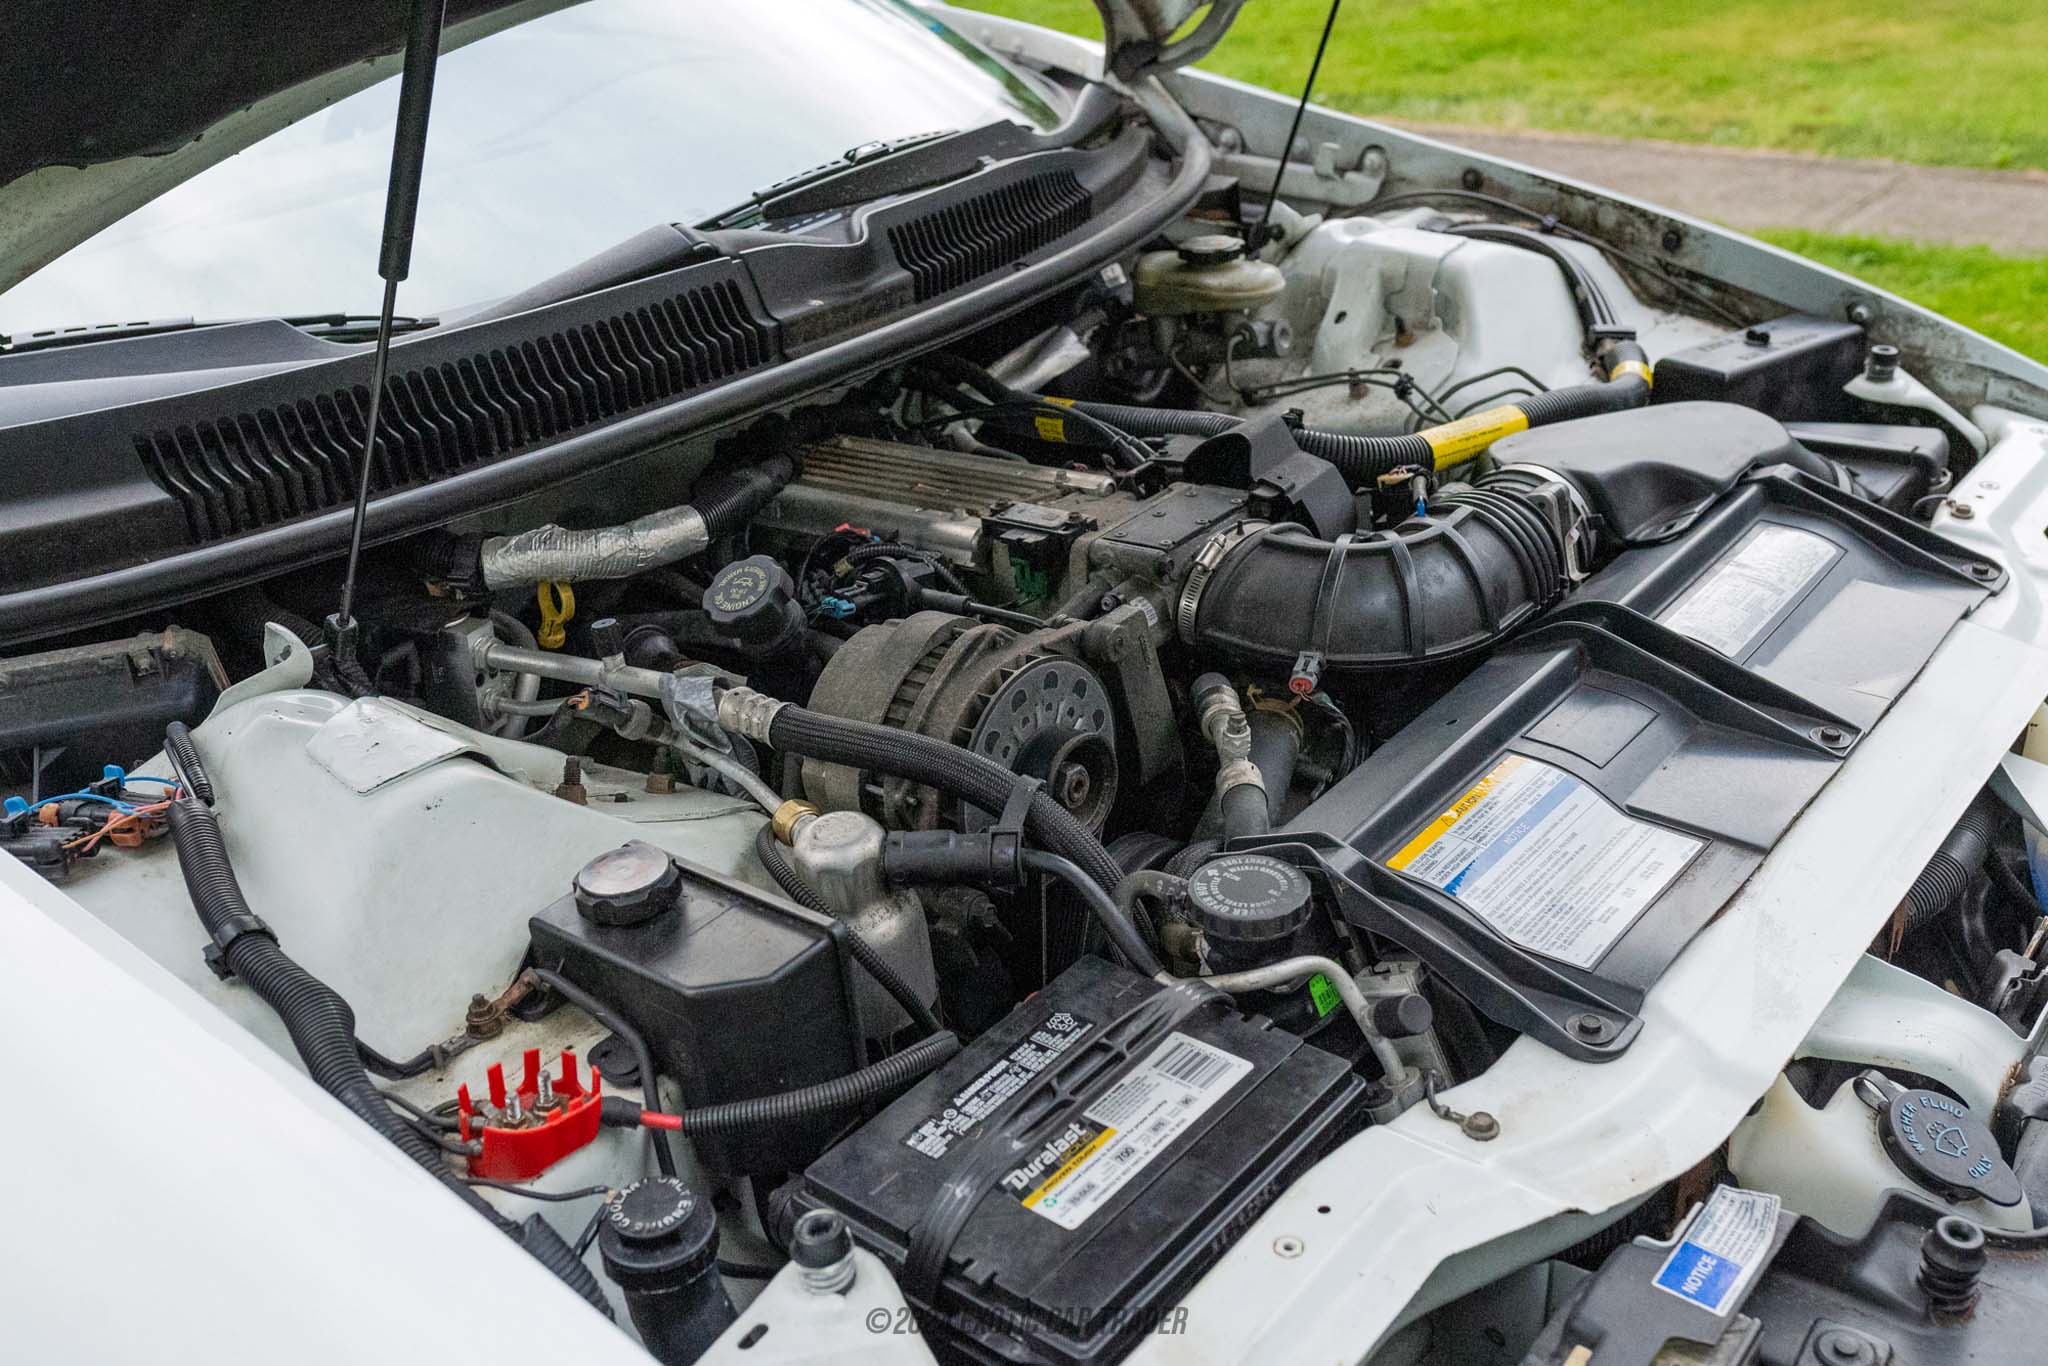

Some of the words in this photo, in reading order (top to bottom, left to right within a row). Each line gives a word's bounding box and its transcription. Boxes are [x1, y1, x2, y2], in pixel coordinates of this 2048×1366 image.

[1501, 820, 1530, 846] NOTICE
[1901, 1102, 1927, 1155] WASHER
[1919, 1096, 1964, 1119] FLUID
[1000, 1122, 1087, 1190] Duralast
[1112, 1145, 1135, 1163] 700
[1967, 1154, 1994, 1179] ONLY
[1681, 1254, 1717, 1295] NOTICE
